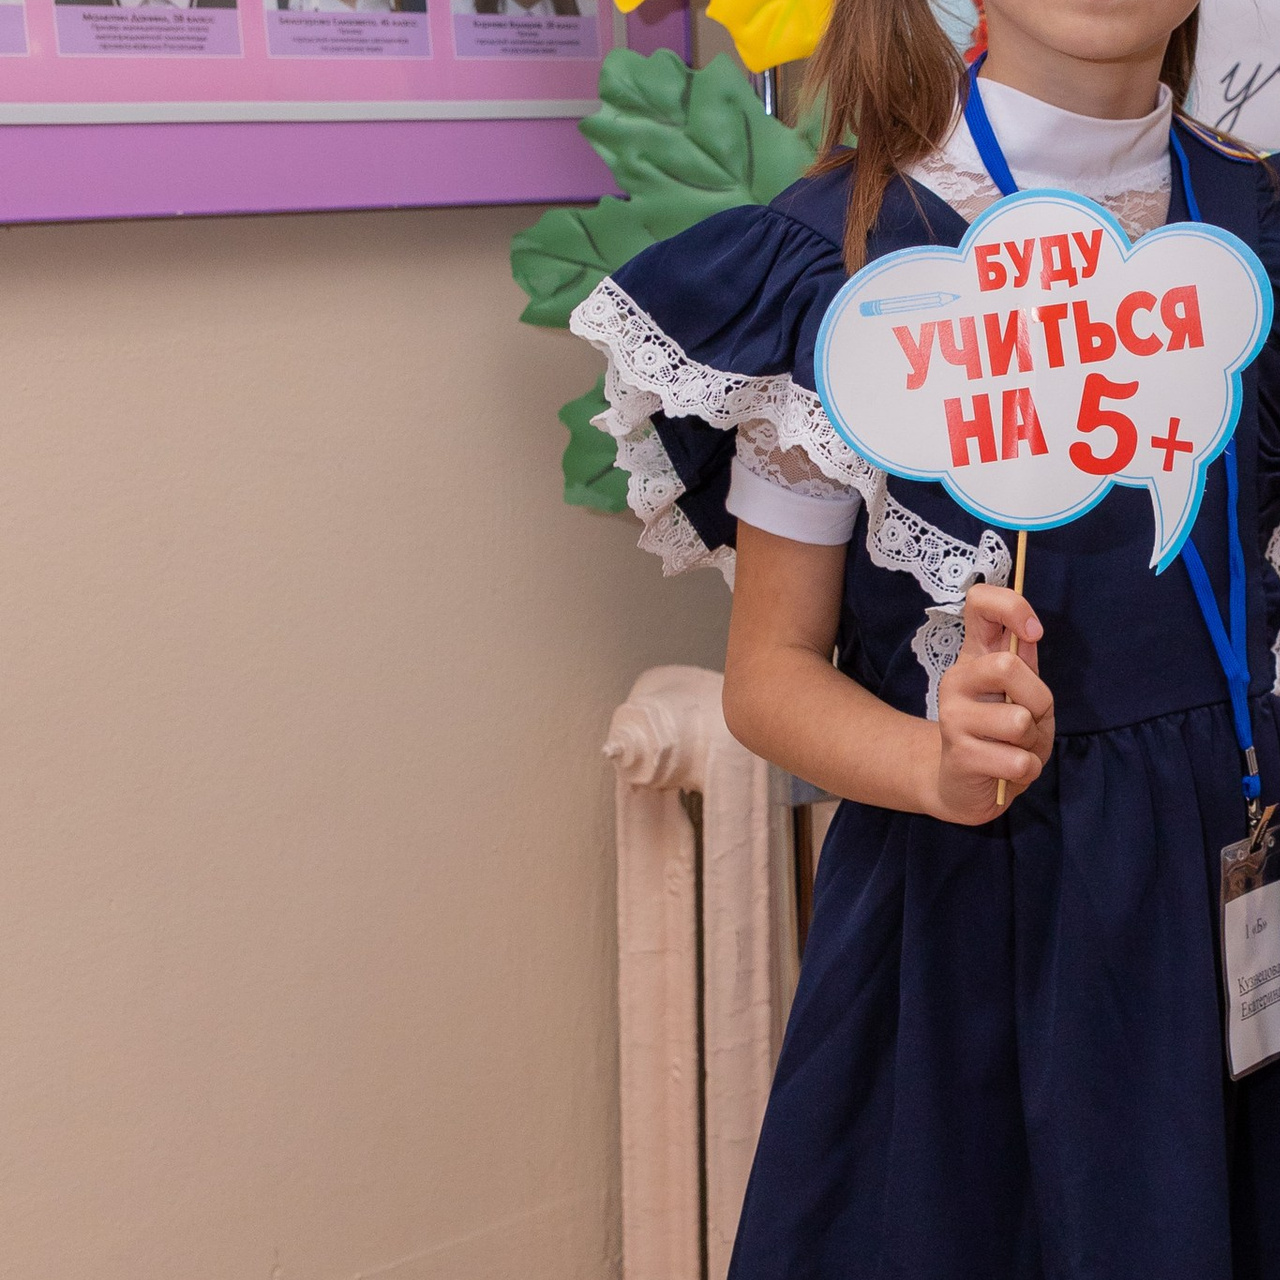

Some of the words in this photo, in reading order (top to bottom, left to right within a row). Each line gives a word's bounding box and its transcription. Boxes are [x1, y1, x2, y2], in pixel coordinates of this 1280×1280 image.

[974, 228, 1104, 292] БУДУ
[891, 284, 1205, 391] УЧИТЬСЯ
[943, 386, 1049, 468] НА
[1068, 372, 1194, 476] 5+
